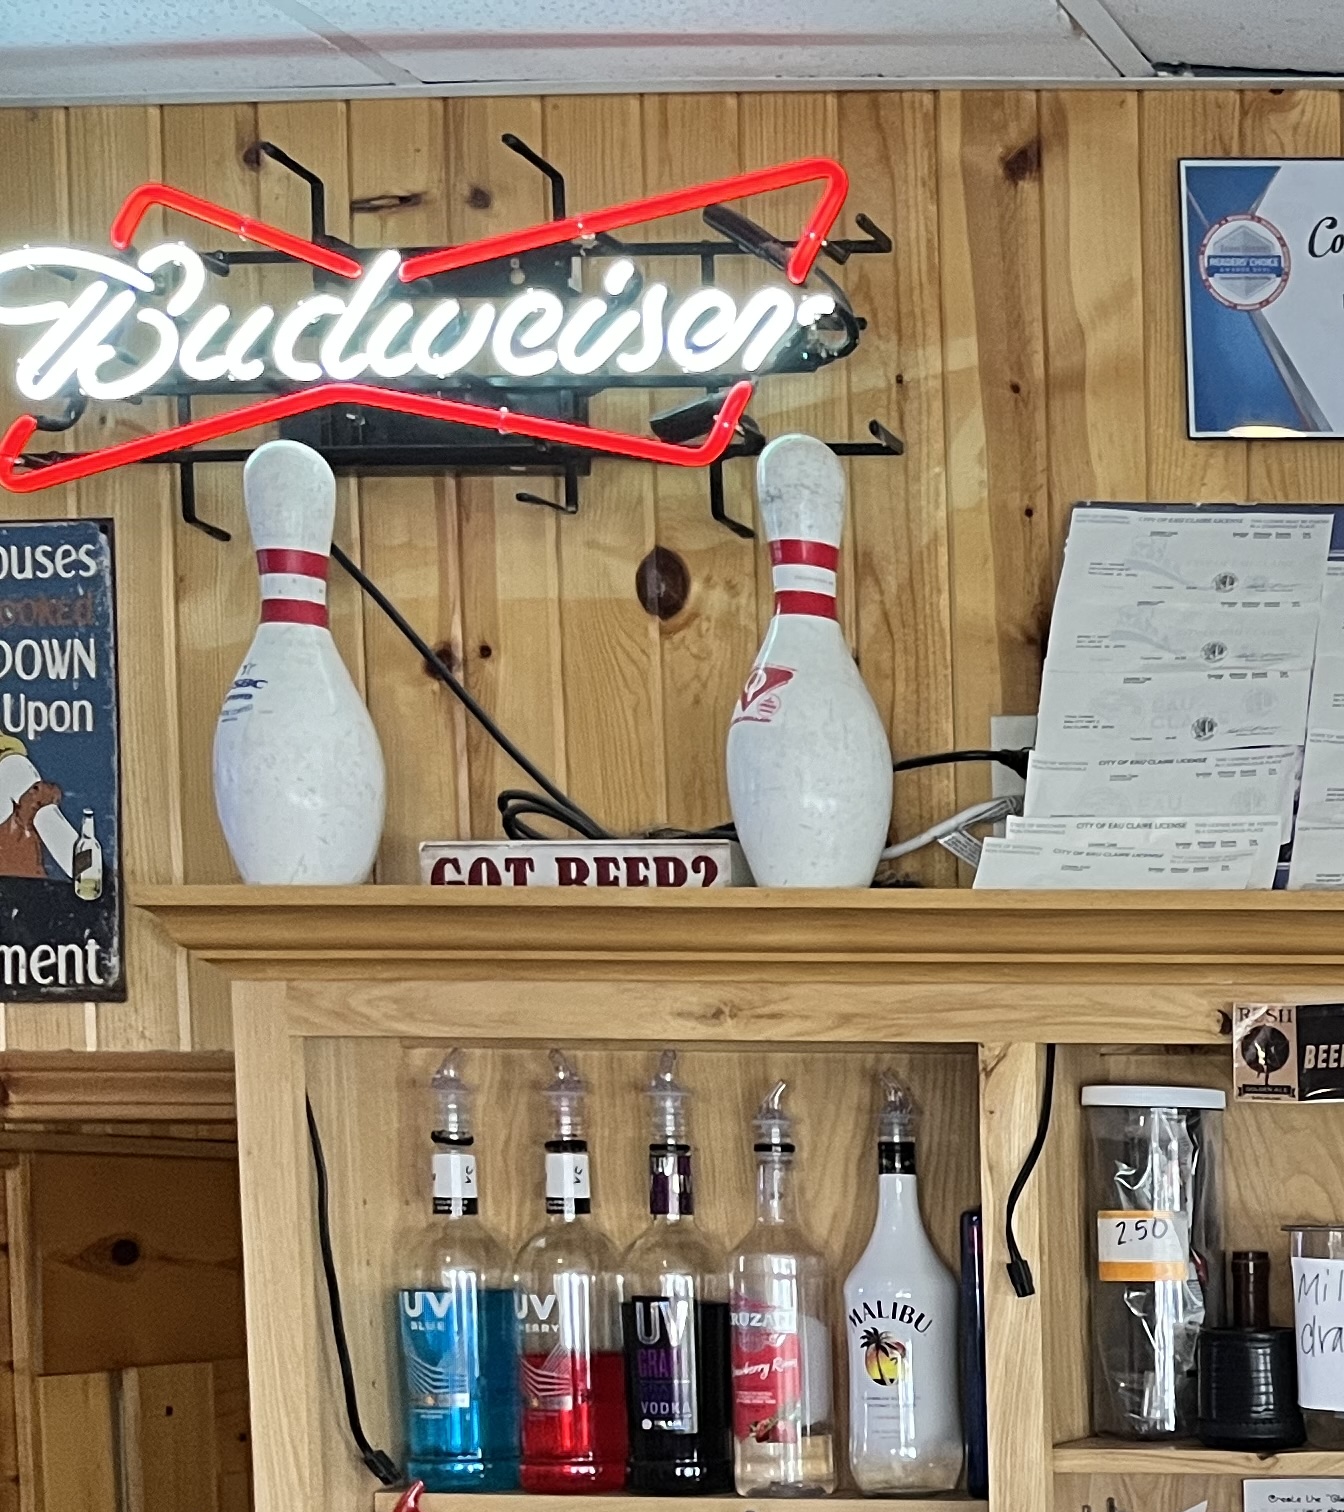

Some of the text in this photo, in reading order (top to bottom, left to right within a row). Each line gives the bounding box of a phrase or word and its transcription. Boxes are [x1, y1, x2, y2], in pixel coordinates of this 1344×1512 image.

[0, 243, 836, 402] Budweiser
[3, 694, 94, 740] Upon
[403, 1292, 453, 1318] UV
[635, 1301, 688, 1347] UV
[848, 1300, 932, 1336] MALIBU
